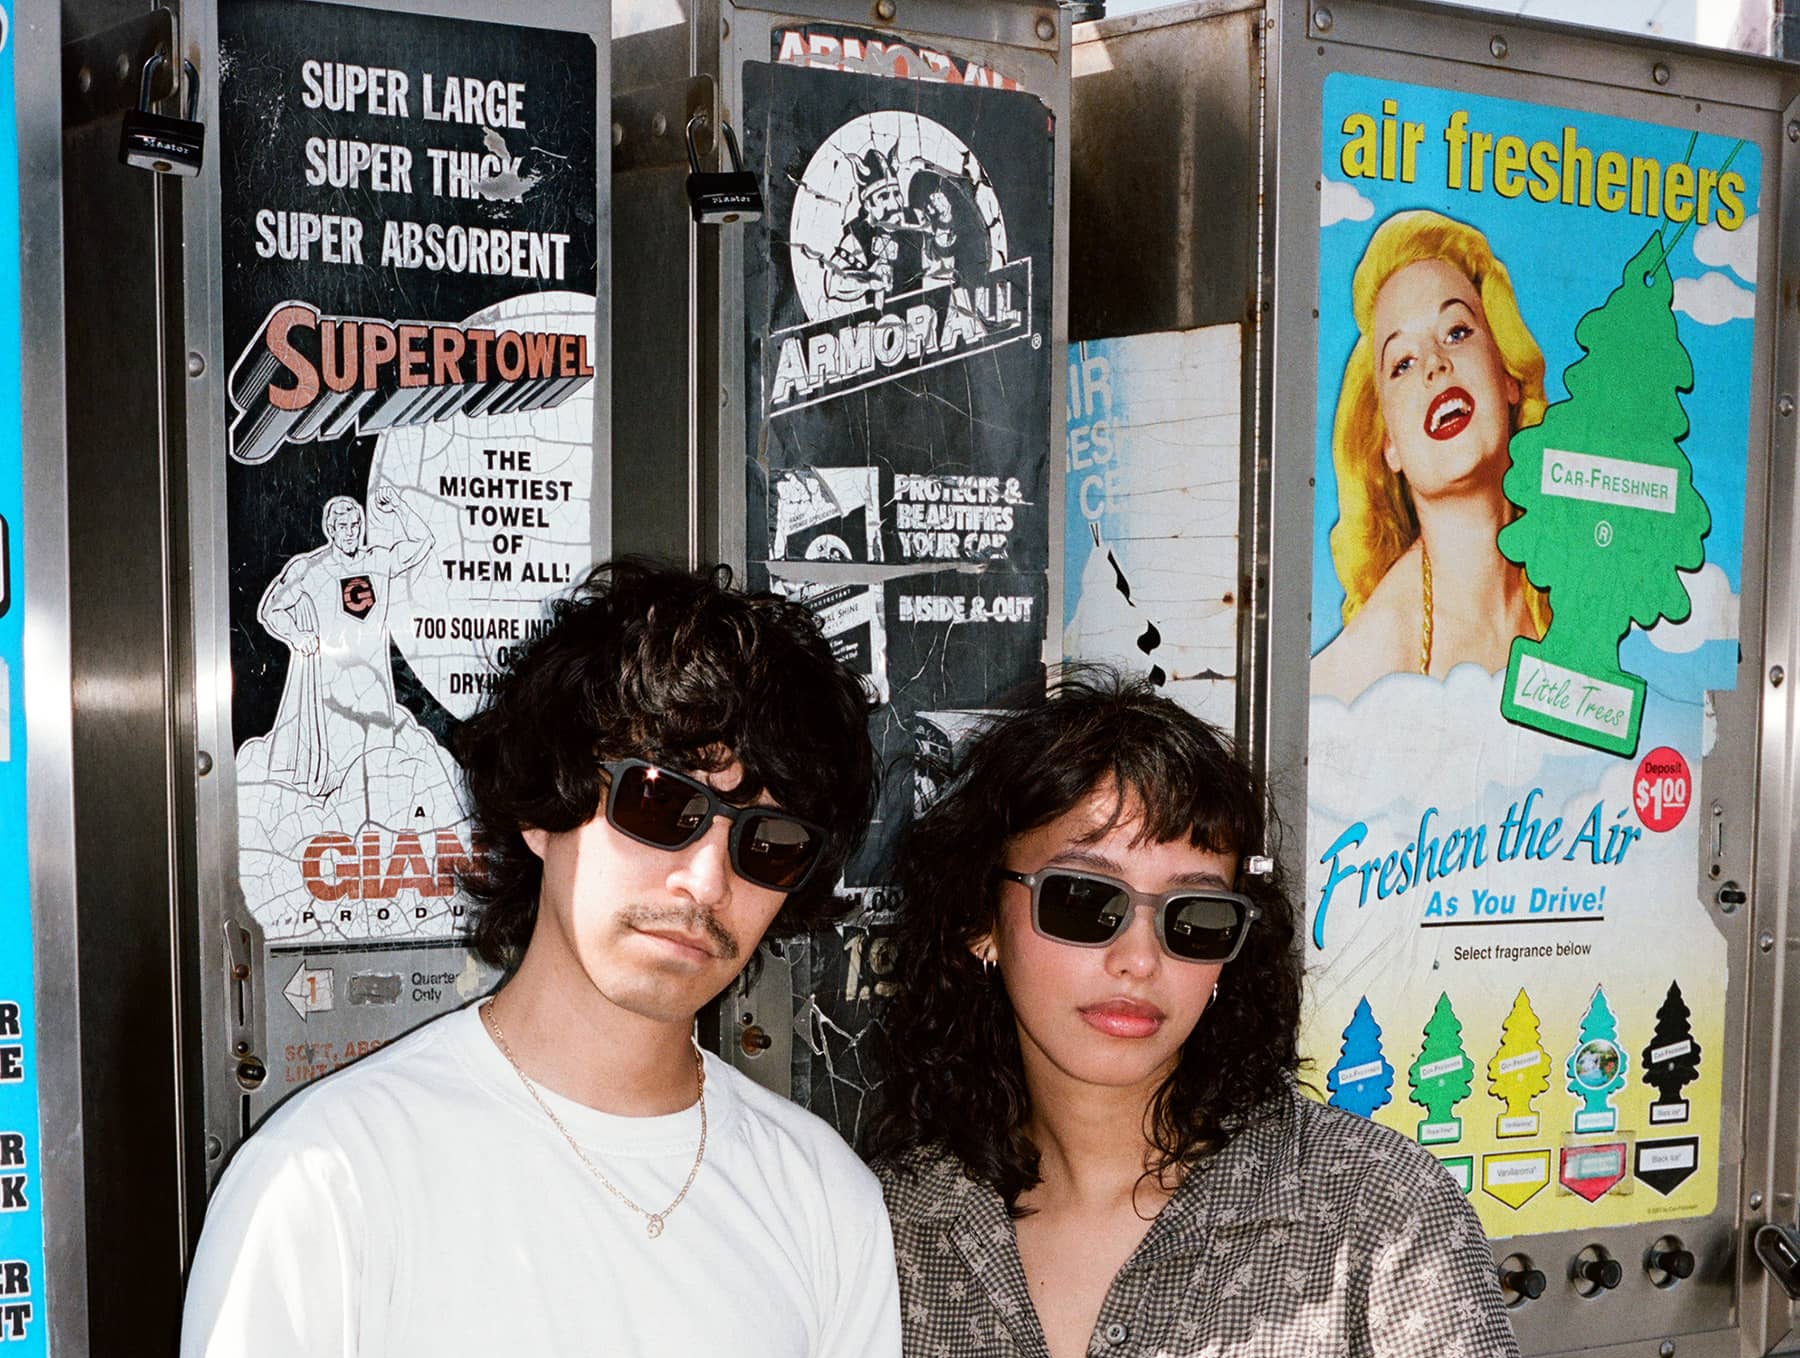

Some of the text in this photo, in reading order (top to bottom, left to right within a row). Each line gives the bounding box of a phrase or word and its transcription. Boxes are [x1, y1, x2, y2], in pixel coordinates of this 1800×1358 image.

[302, 60, 525, 129] SUPER LARGE
[305, 137, 412, 194] SUPER
[1340, 99, 1746, 232] air fresheners
[255, 209, 570, 280] SUPER ABSORBENT
[772, 304, 938, 403] ARMOR
[940, 280, 1021, 352] ALL
[265, 305, 594, 411] SUPERTOWEL
[484, 450, 531, 471] THE
[439, 476, 573, 501] MIGHTIEST
[1002, 477, 1023, 504] &
[466, 506, 549, 528] TOWEL
[897, 503, 1014, 532] BEAUTIFIES
[493, 535, 523, 554] OF
[899, 531, 960, 558] YOUR
[443, 561, 570, 582] THEM ALL!
[899, 595, 1033, 622] INSIDE & OUT
[414, 618, 446, 639] 700
[451, 618, 519, 640] SQUARE
[1521, 668, 1626, 728] Little Trees
[1645, 762, 1682, 776] Deposit
[415, 806, 425, 817] A
[1313, 788, 1642, 951] Freshen the Air
[1424, 886, 1607, 918] As You Drive!
[1453, 941, 1592, 962] Select fragrance below
[412, 987, 442, 1004] Only
